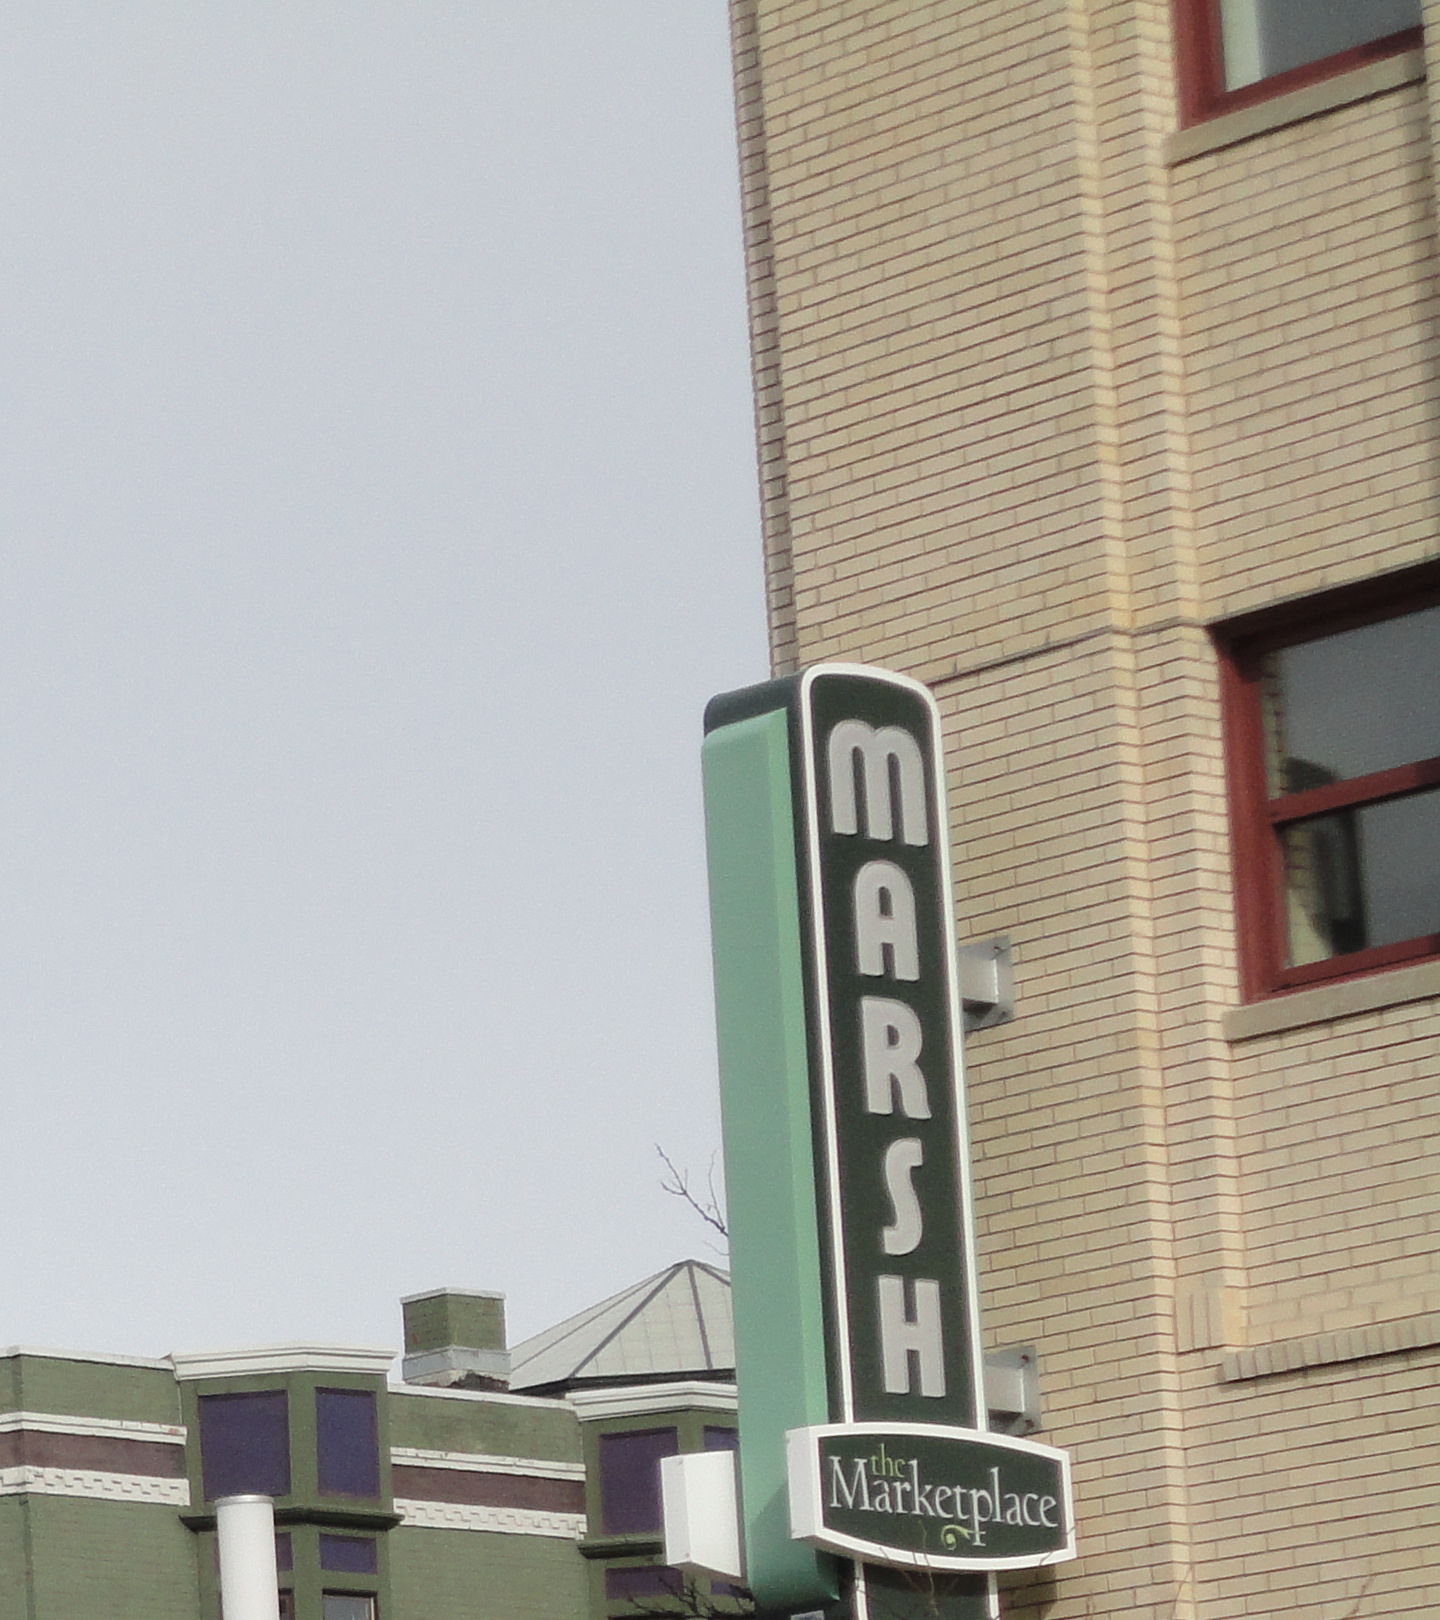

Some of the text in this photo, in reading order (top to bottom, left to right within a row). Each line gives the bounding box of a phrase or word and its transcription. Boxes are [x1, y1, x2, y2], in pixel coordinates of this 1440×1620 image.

[828, 718, 946, 1399] MARSH
[828, 1456, 1059, 1547] Marketplace
[871, 1443, 905, 1478] the
